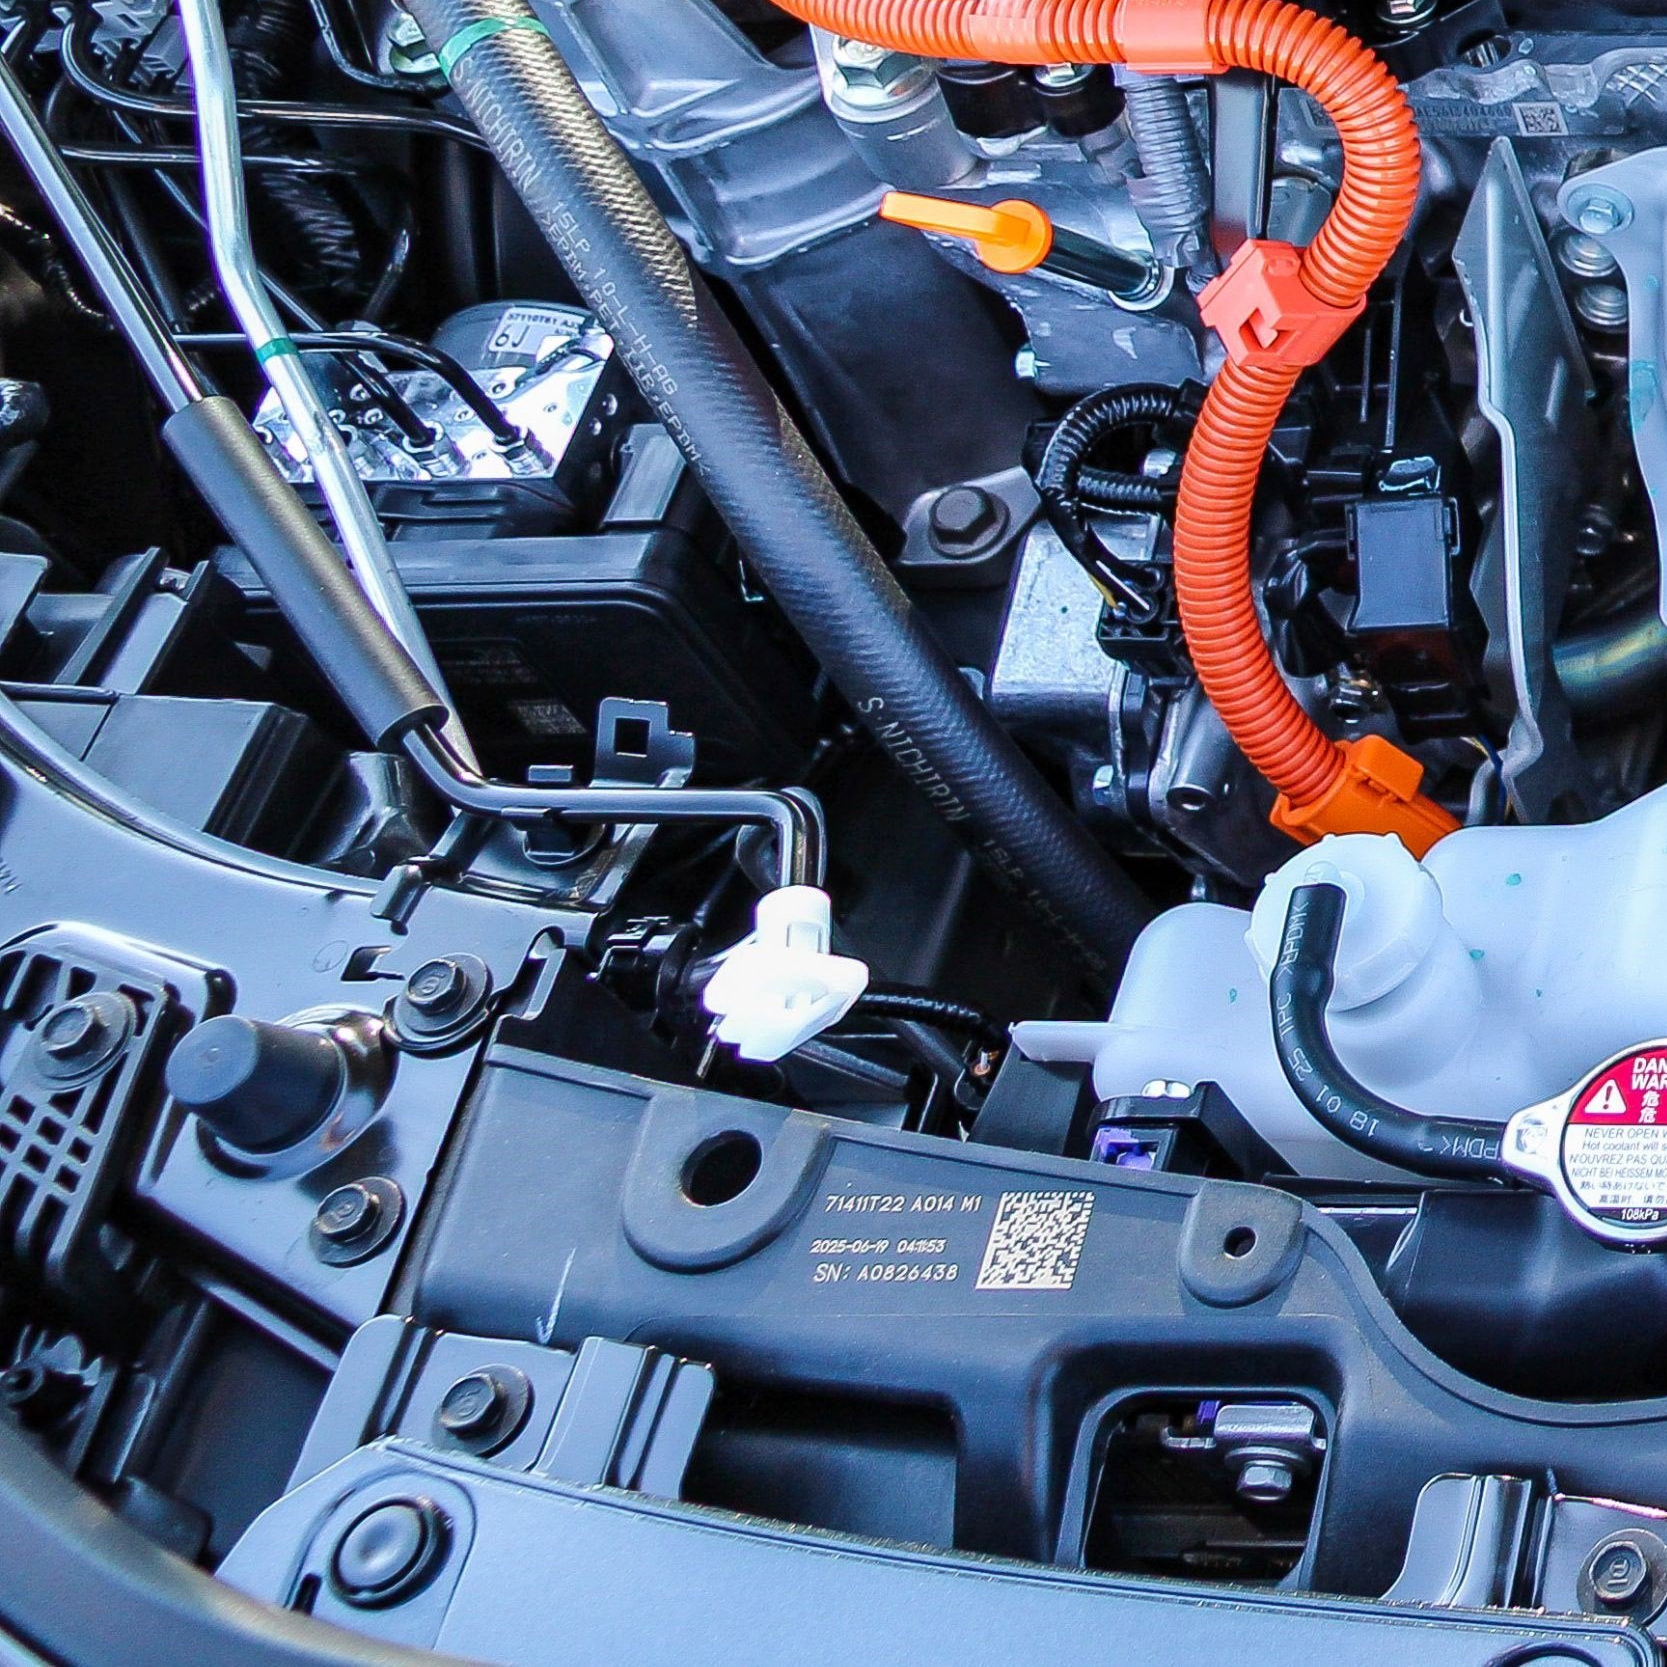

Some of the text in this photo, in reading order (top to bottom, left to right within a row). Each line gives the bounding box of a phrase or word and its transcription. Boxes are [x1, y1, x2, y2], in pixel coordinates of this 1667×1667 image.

[1287, 1047, 1313, 1081] 25
[1315, 1085, 1342, 1113] 01
[1350, 1110, 1380, 1137] 18
[1585, 1128, 1624, 1139] NEVER
[1628, 1128, 1659, 1139] OPEN
[1582, 1141, 1600, 1152] Hot
[1603, 1141, 1640, 1152] coolant
[1643, 1141, 1659, 1152] will
[1570, 1154, 1623, 1165] N'OUVREZ
[1626, 1154, 1648, 1165] PAS
[1571, 1167, 1597, 1179] NICHT
[1600, 1167, 1615, 1179] BEI
[825, 1195, 983, 1212] 71411T22 A014 M1
[1620, 1209, 1660, 1221] 108kPa
[809, 1239, 890, 1254] 2025-06-19
[813, 1263, 959, 1283] SN: A0826438
